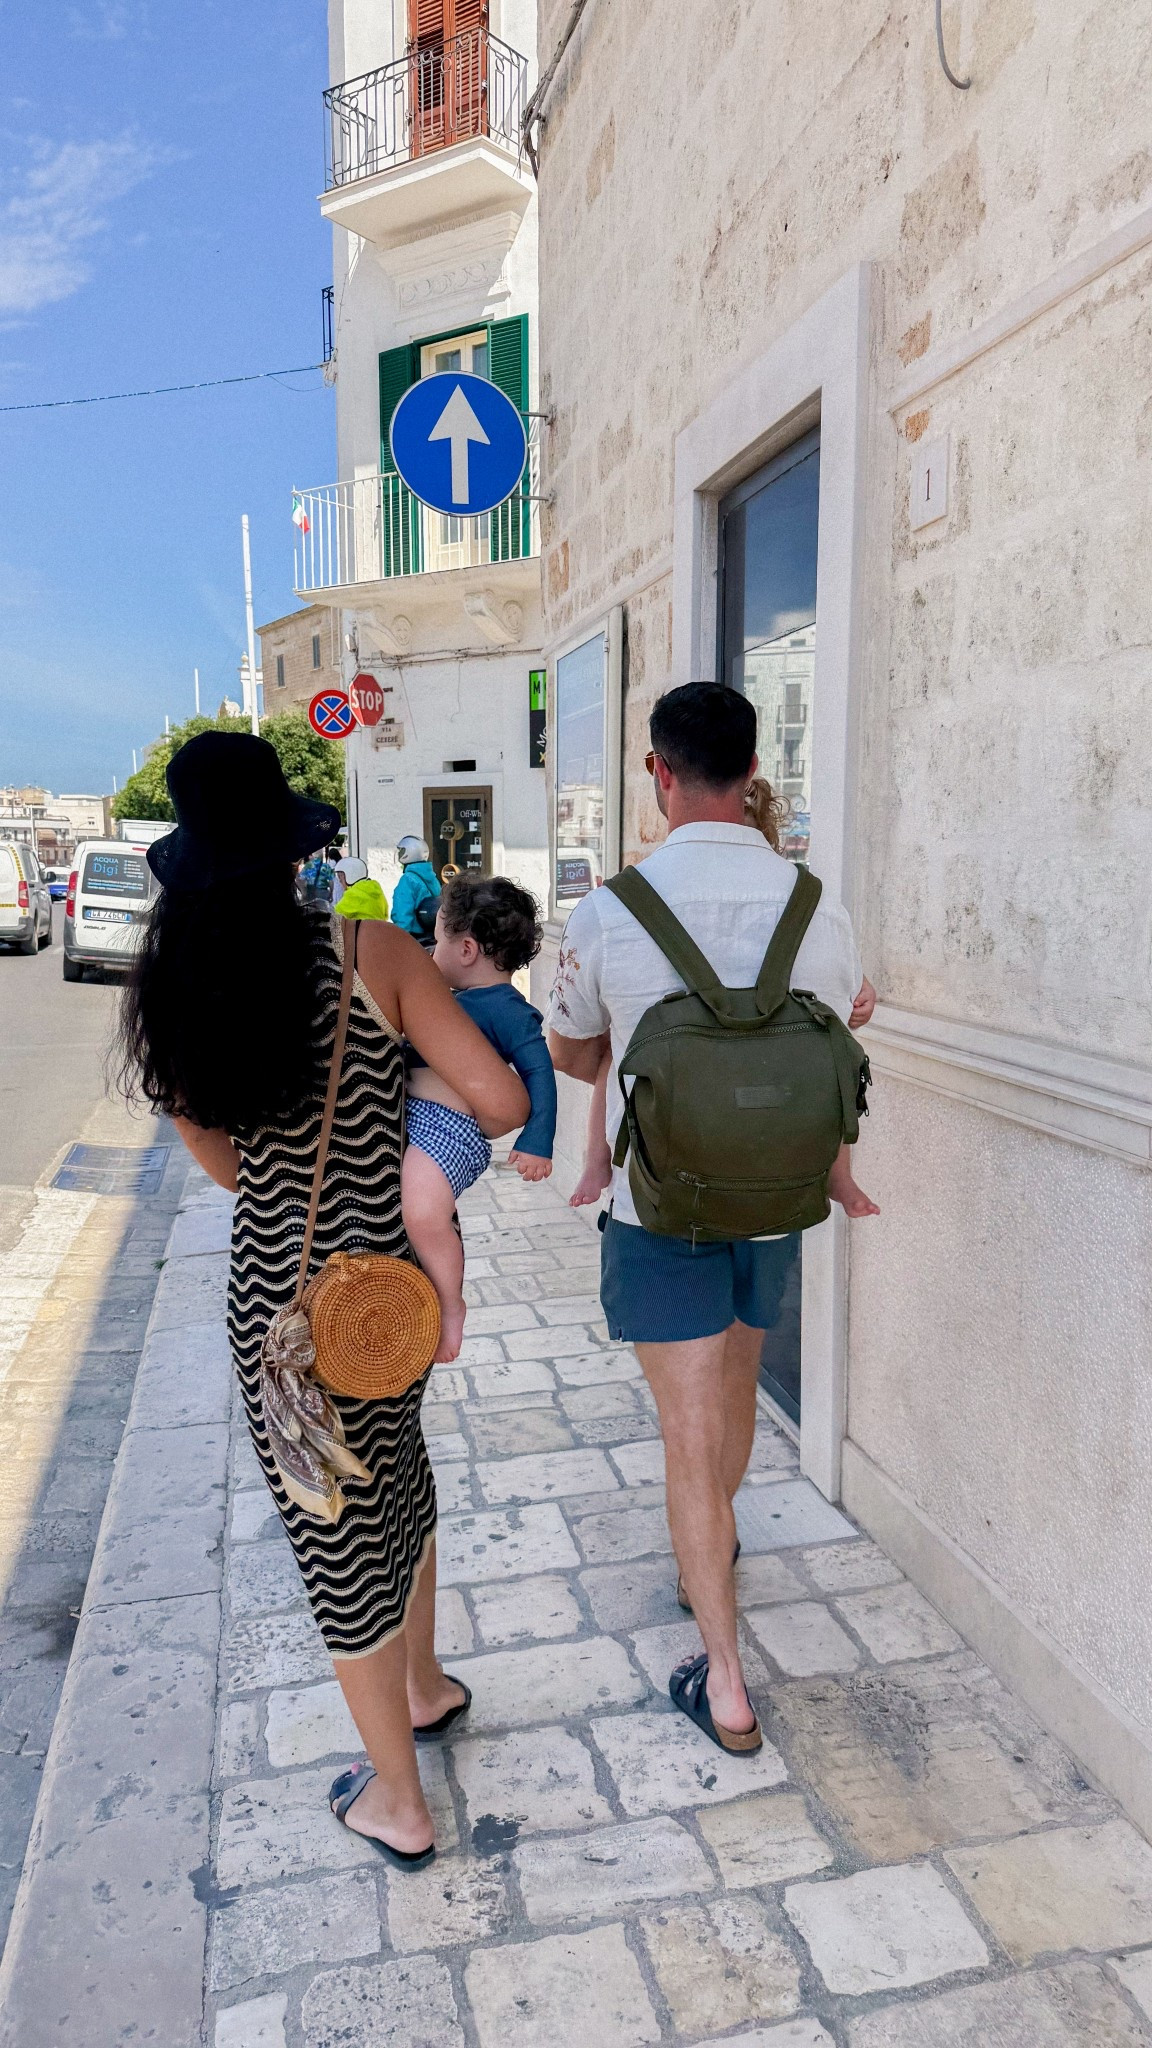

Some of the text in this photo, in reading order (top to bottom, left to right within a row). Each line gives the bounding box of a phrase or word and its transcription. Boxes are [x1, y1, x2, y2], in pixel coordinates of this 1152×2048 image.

[925, 467, 931, 501] 1
[351, 688, 383, 712] STOP
[93, 863, 119, 876] Digi
